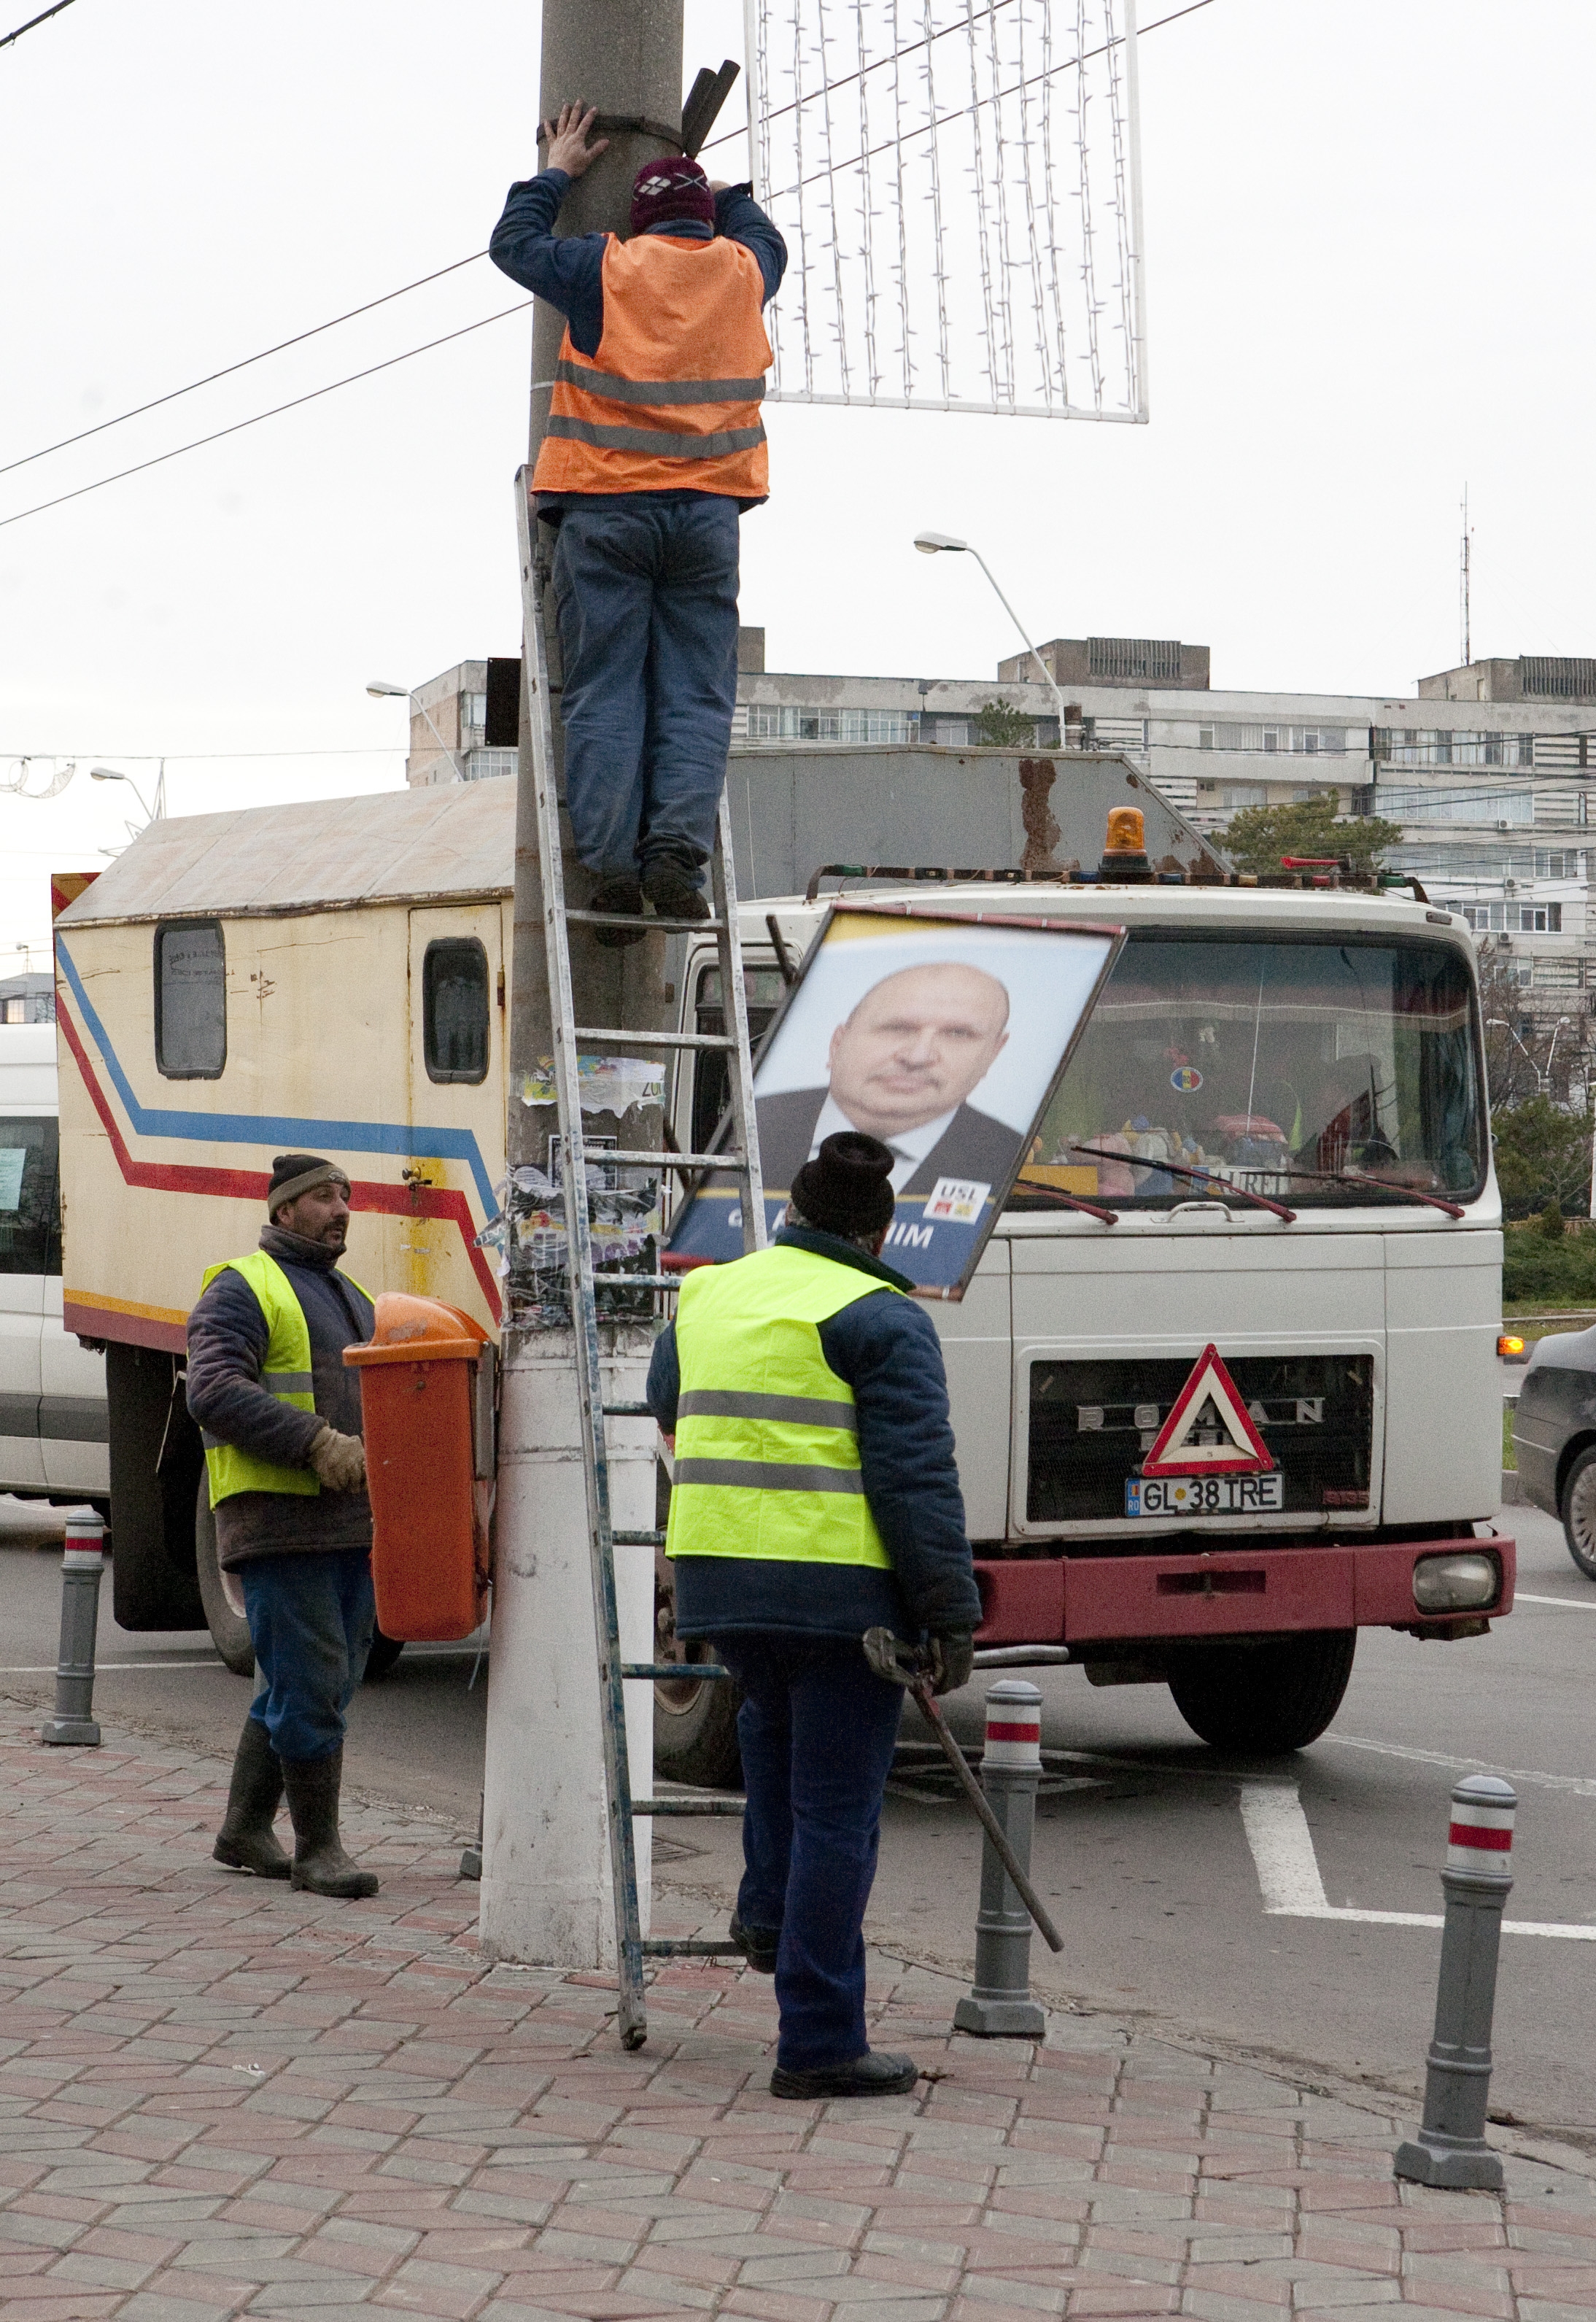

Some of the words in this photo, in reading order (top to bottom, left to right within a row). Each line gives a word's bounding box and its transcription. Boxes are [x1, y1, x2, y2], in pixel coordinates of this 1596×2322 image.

[941, 1184, 977, 1201] USL
[1144, 1482, 1178, 1511] GL
[1189, 1479, 1220, 1509] 38
[1224, 1477, 1277, 1507] TRE
[1128, 1500, 1140, 1512] RO
